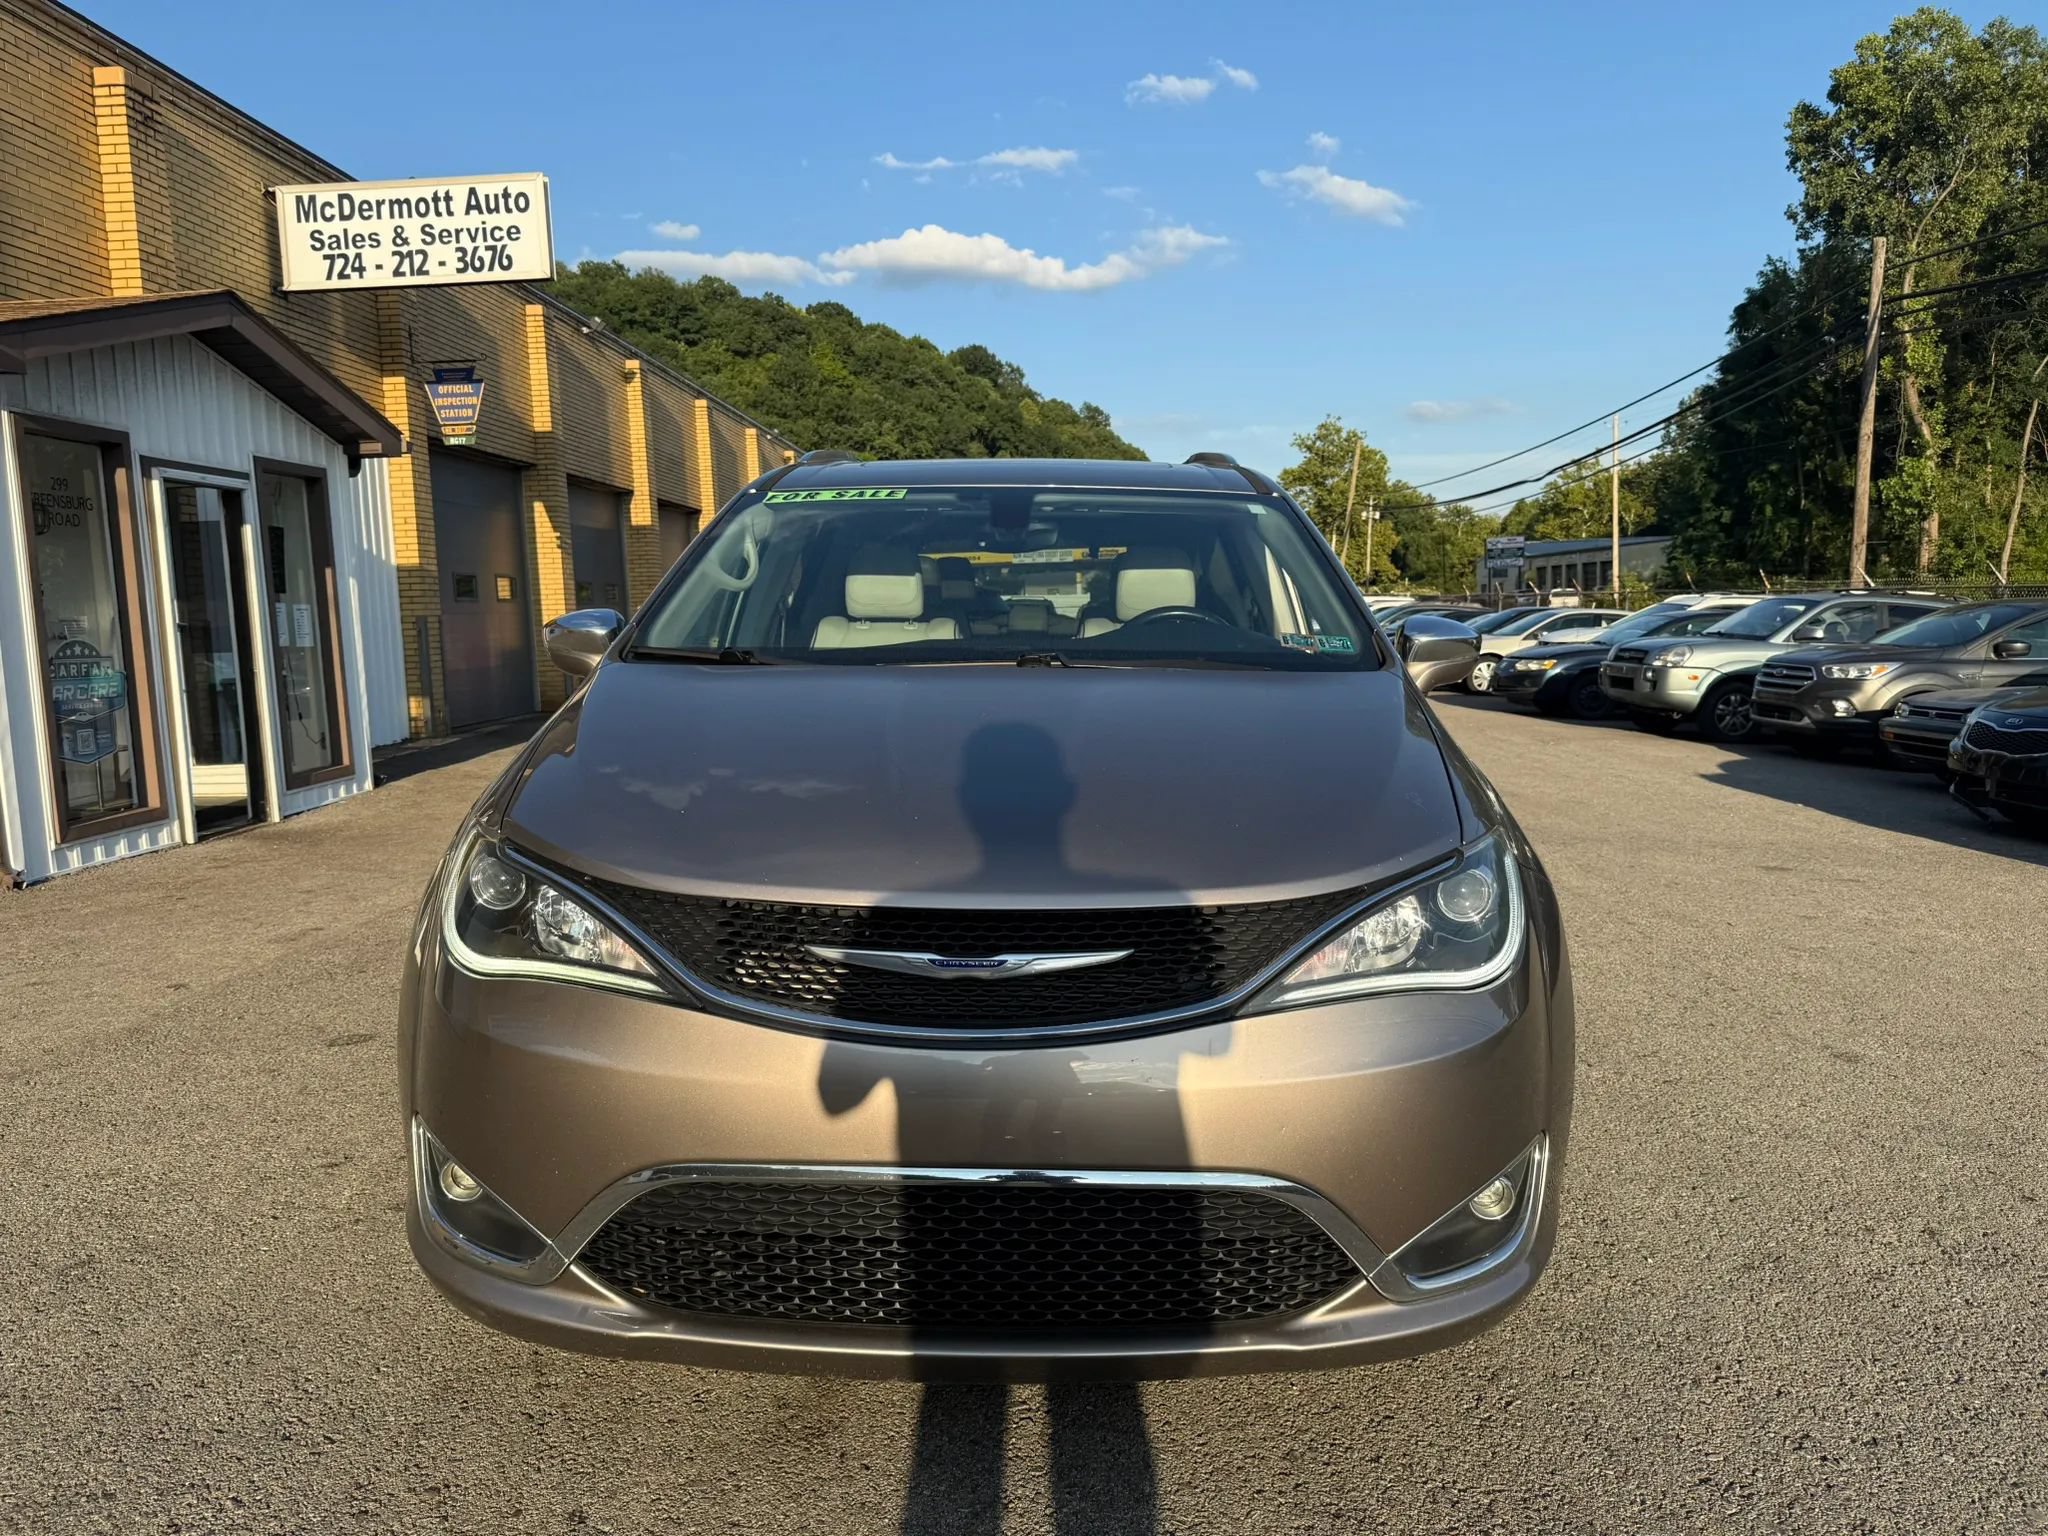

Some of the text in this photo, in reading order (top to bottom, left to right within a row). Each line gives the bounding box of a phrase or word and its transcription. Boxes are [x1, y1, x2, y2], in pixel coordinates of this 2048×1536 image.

[295, 185, 530, 223] McDermott Auto
[309, 221, 521, 252] Sales & Service
[322, 252, 367, 280] 724
[391, 249, 430, 277] 212
[455, 244, 513, 273] 3676
[438, 384, 474, 394] OFFICIAL
[434, 396, 478, 406] INSPECTION
[440, 408, 473, 418] STATION
[49, 476, 69, 491] 299
[32, 492, 94, 511] REENSBURG
[767, 489, 902, 502] FOR SALE
[48, 512, 81, 527] ROAD
[77, 682, 119, 699] CARE
